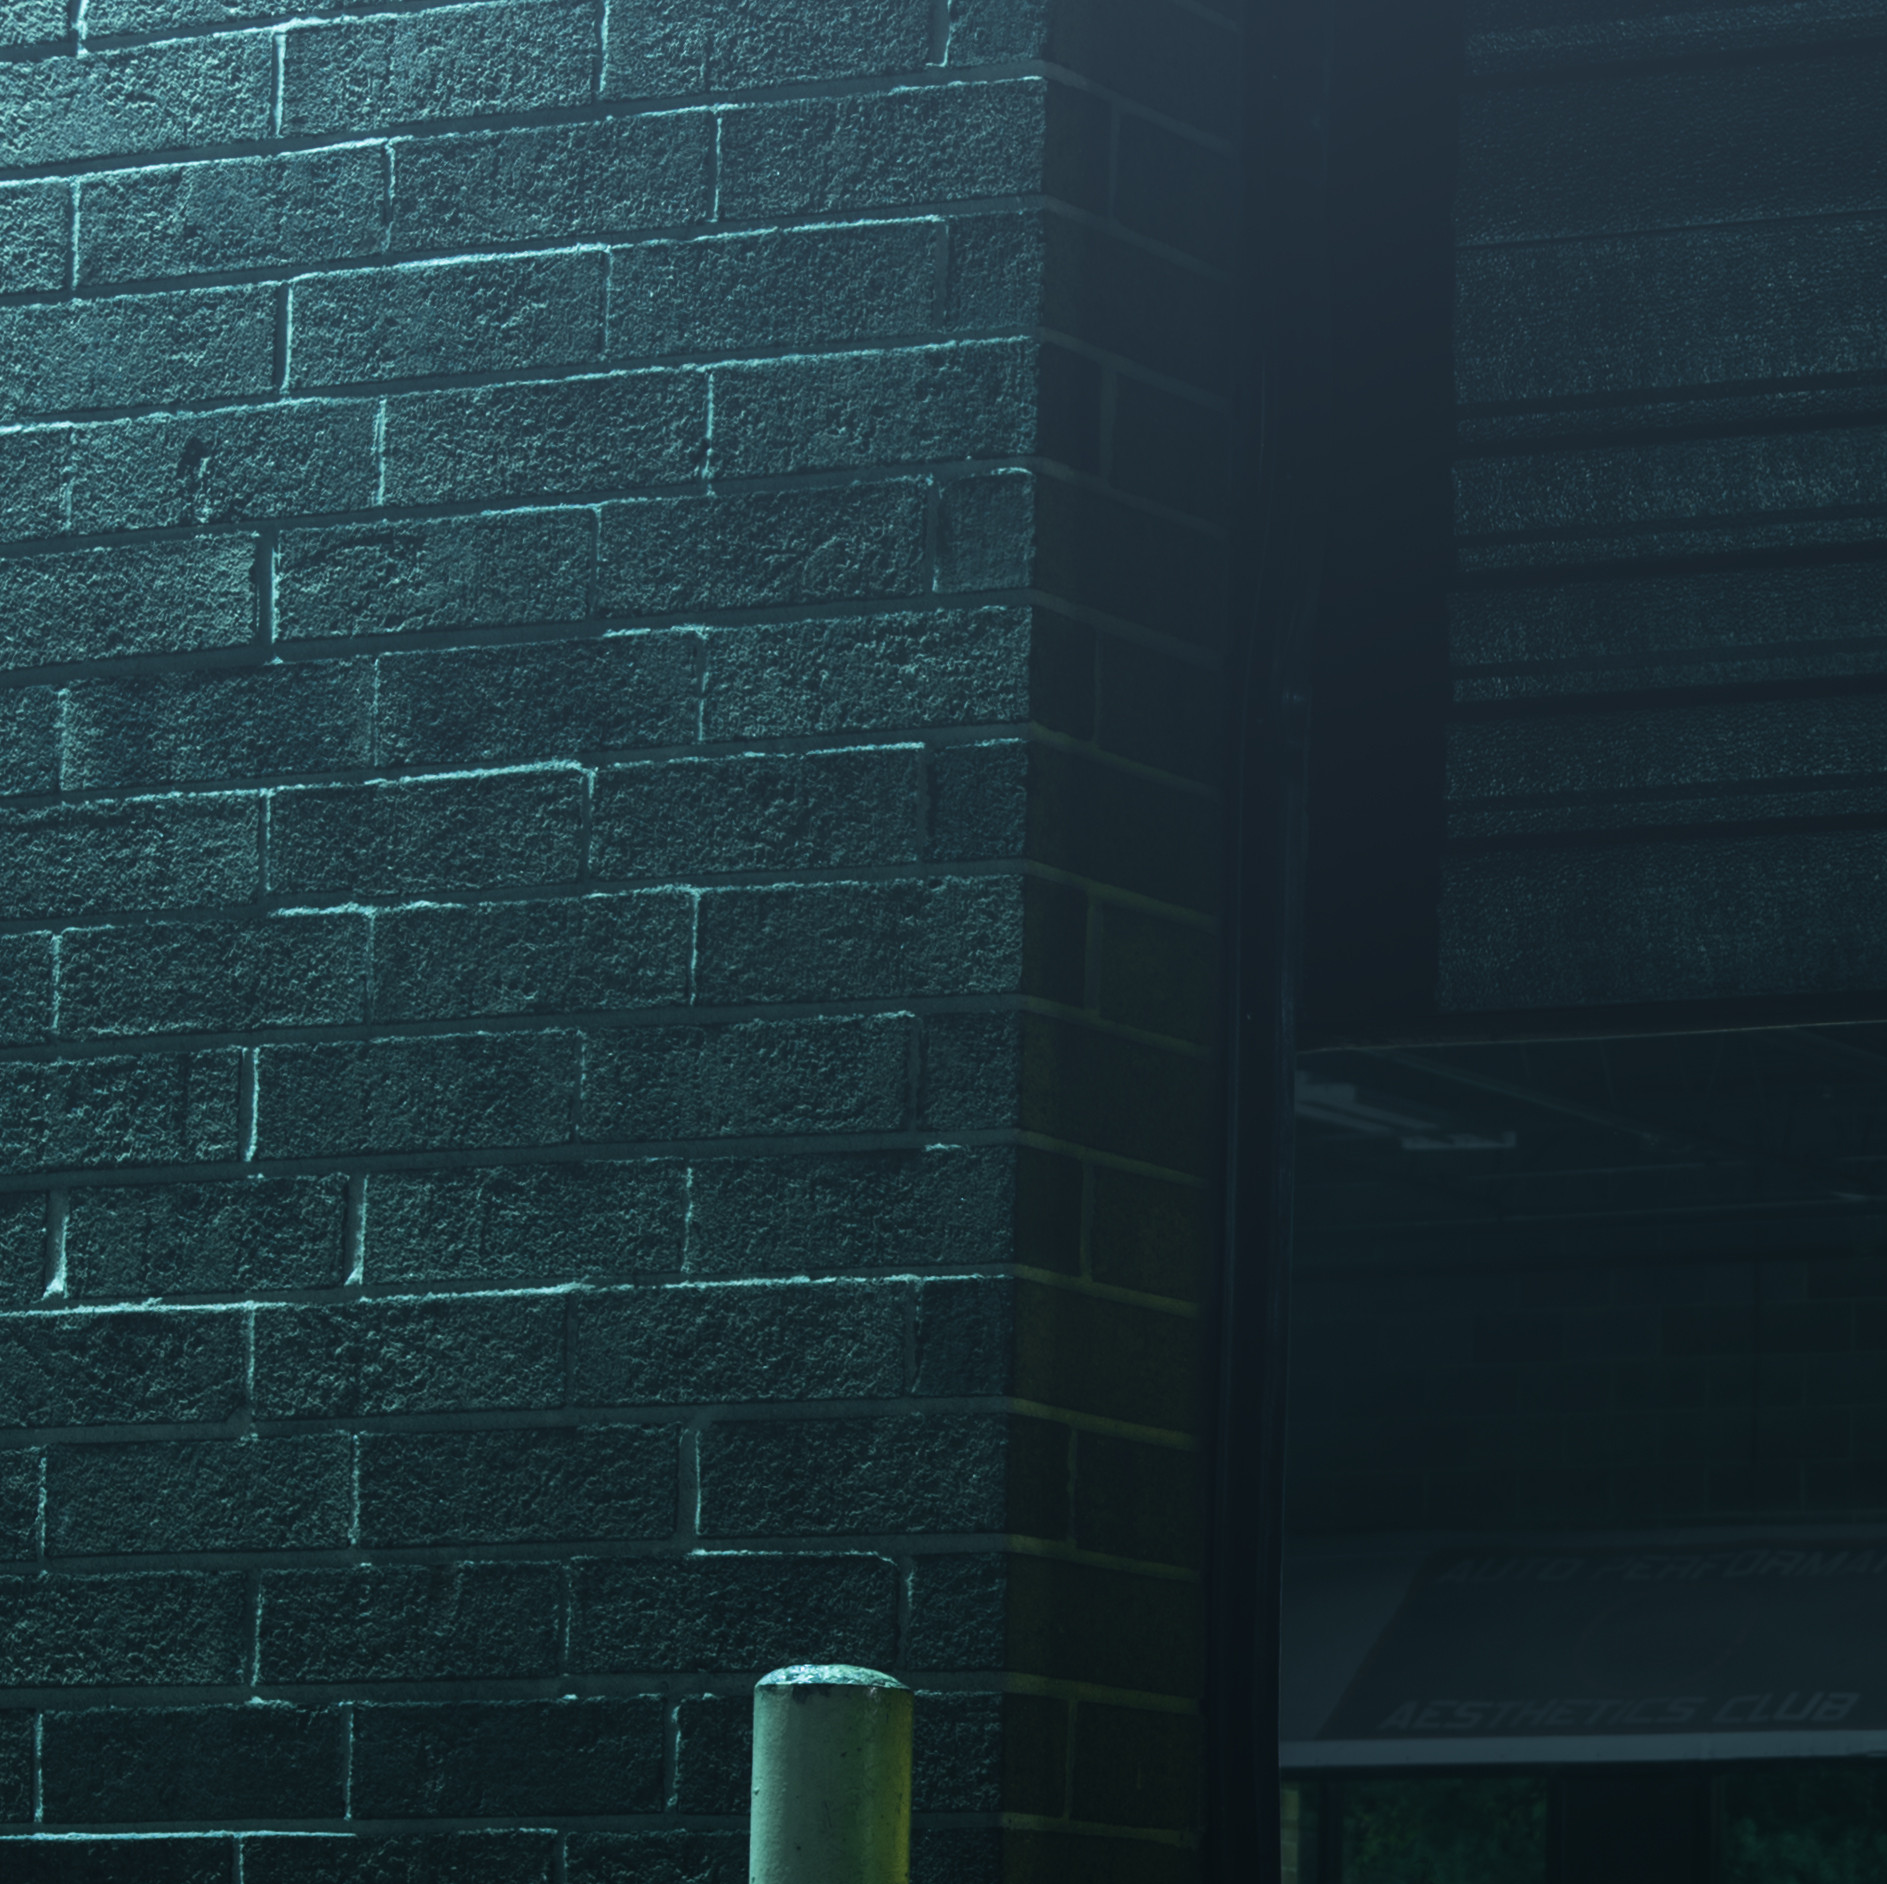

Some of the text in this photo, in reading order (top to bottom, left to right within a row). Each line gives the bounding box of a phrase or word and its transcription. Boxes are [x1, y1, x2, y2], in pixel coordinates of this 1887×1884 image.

[1439, 1556, 1582, 1584] AUTO
[1377, 1692, 1861, 1731] AESTHETICS CLUB
